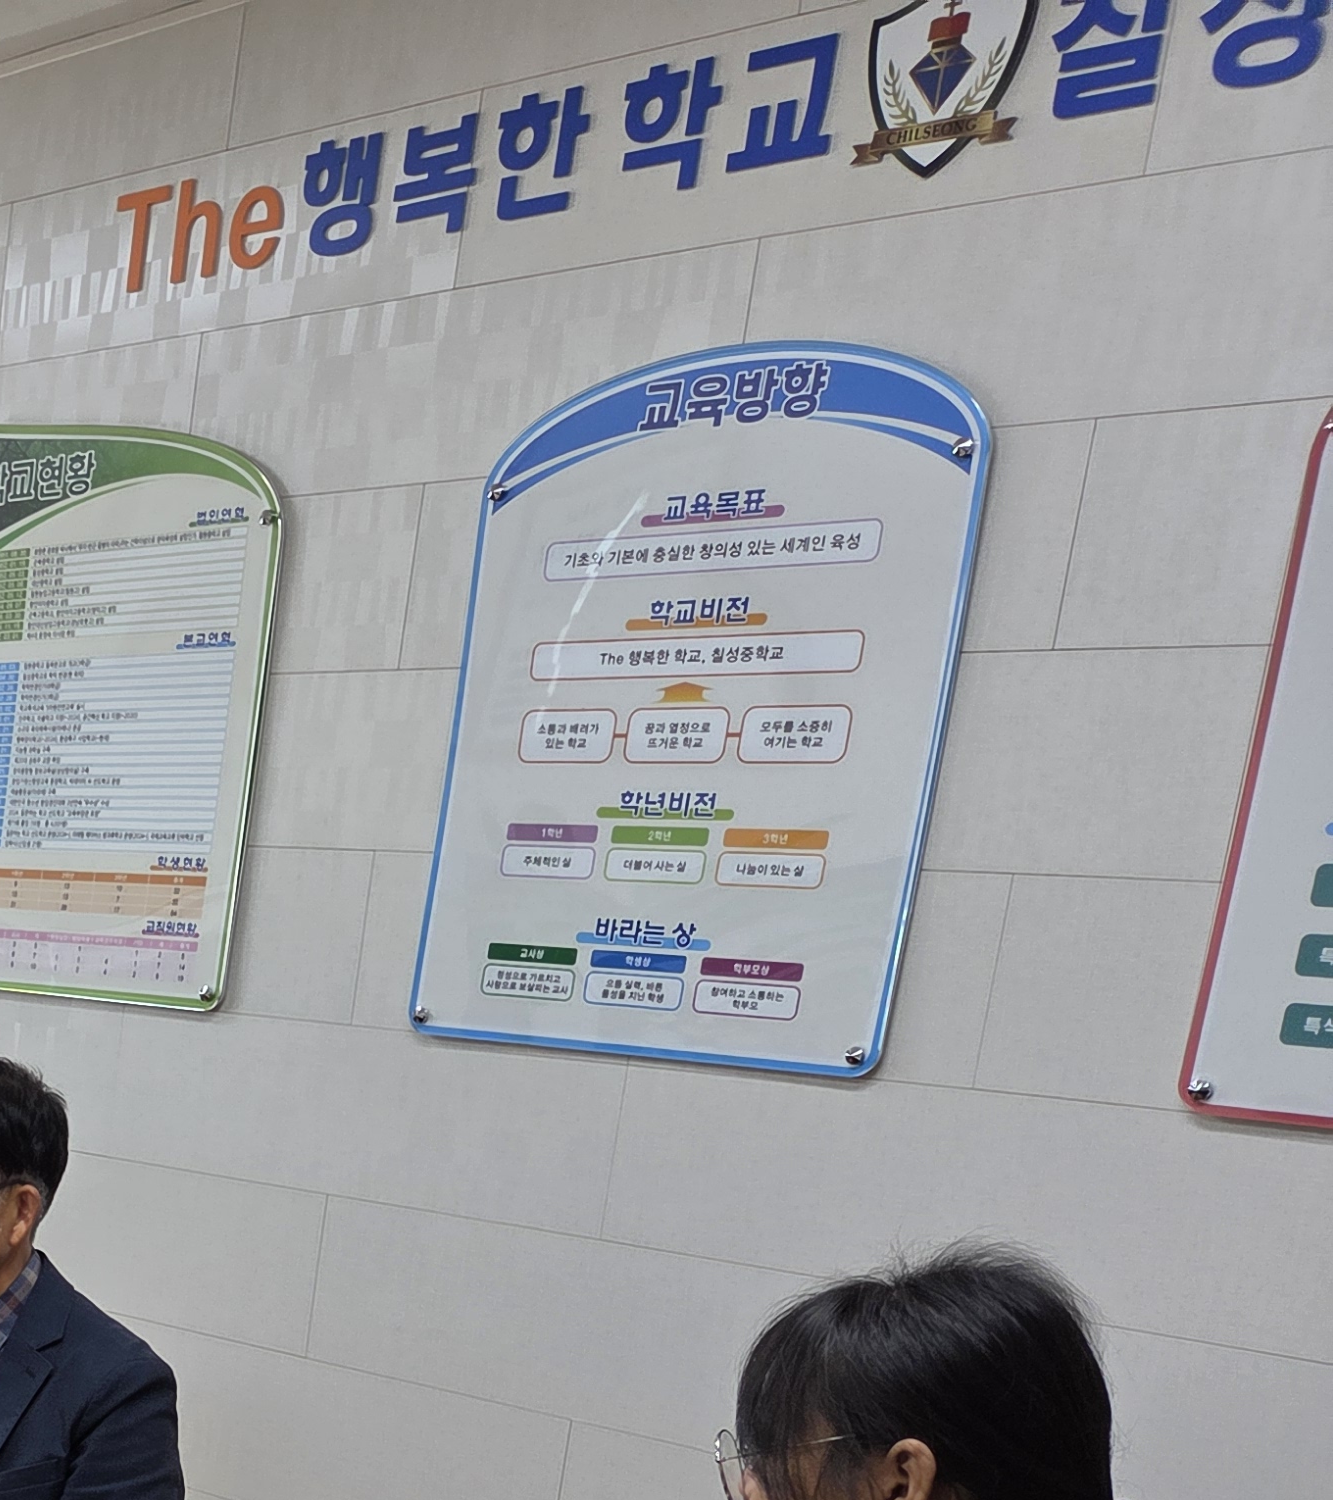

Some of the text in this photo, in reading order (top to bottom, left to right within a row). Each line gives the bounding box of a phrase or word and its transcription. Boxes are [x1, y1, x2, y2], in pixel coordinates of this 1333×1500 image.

[885, 118, 979, 147] CHILSEONG
[118, 178, 285, 295] The
[303, 86, 595, 257] 행복한
[619, 31, 843, 194] 학교
[637, 359, 832, 433] 교육방향
[662, 488, 768, 522] 교육목표
[563, 532, 862, 568] 기초와 기본에 충실한 창의성 있는 세계인 육성
[648, 595, 751, 627] 학교비전
[599, 644, 784, 667] The 행복한 학교, 칠성중학교
[668, 720, 712, 735] 열정으로
[759, 718, 833, 734] 모두를 소중히
[544, 736, 587, 750] 있는 학교
[646, 735, 704, 750] 뜨거운 학교
[763, 734, 824, 749] 여기는 학교
[618, 790, 717, 818] 학년비전
[654, 859, 675, 872] 사는
[770, 864, 791, 877] 있는
[595, 917, 697, 948] 바라는 상
